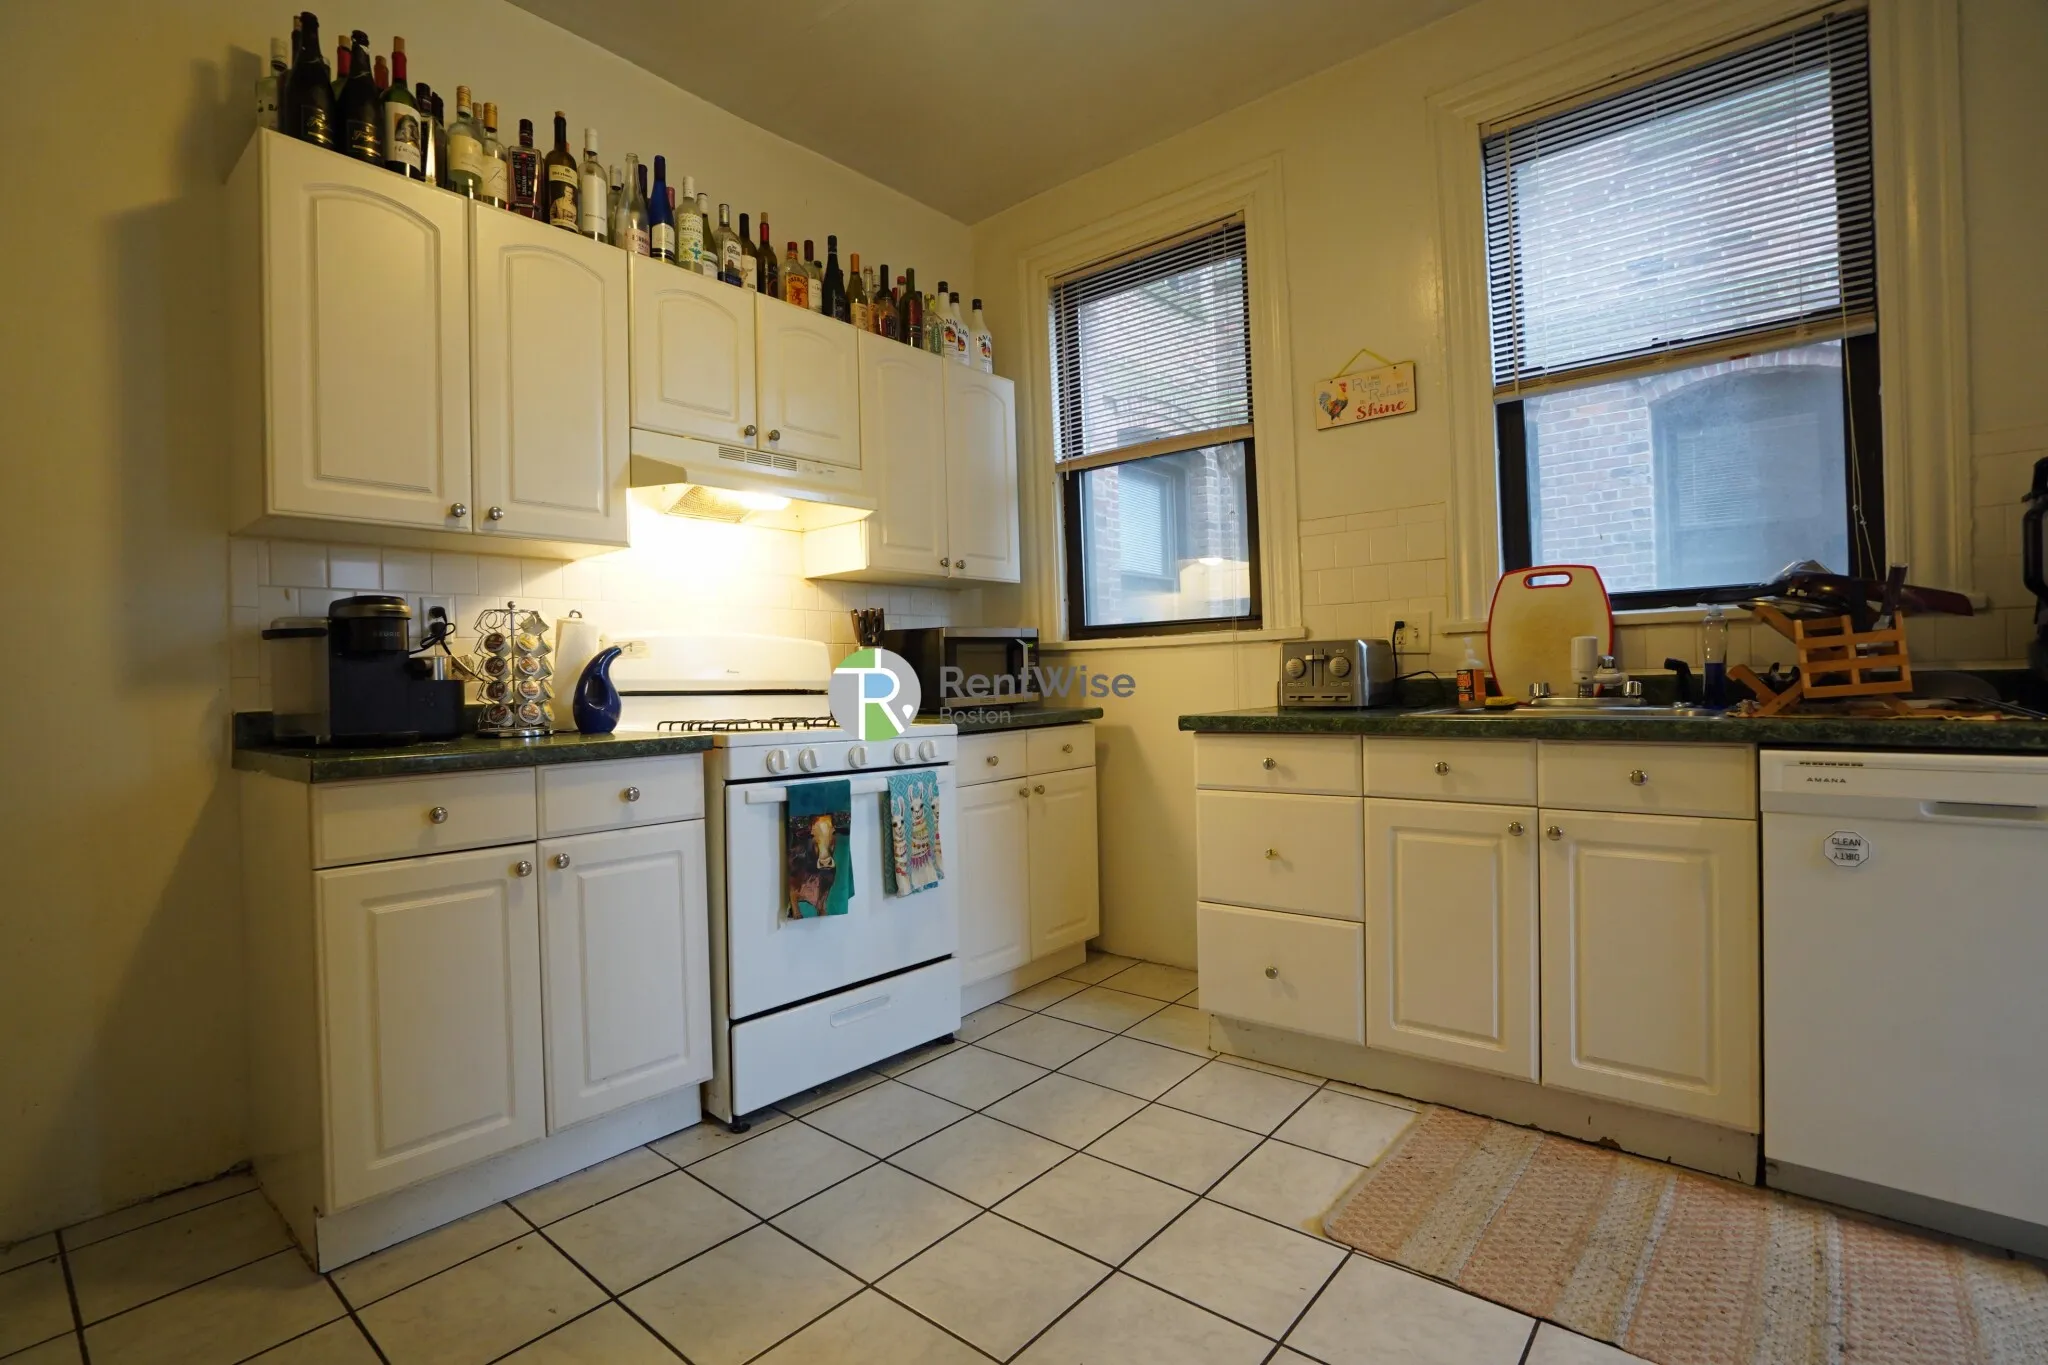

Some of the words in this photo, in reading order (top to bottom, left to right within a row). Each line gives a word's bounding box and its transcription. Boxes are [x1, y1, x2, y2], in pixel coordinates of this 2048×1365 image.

[1356, 400, 1408, 420] Shine
[1806, 776, 1847, 784] AMANA
[1831, 837, 1861, 847] CLEAN
[1833, 852, 1860, 861] DIRTY
